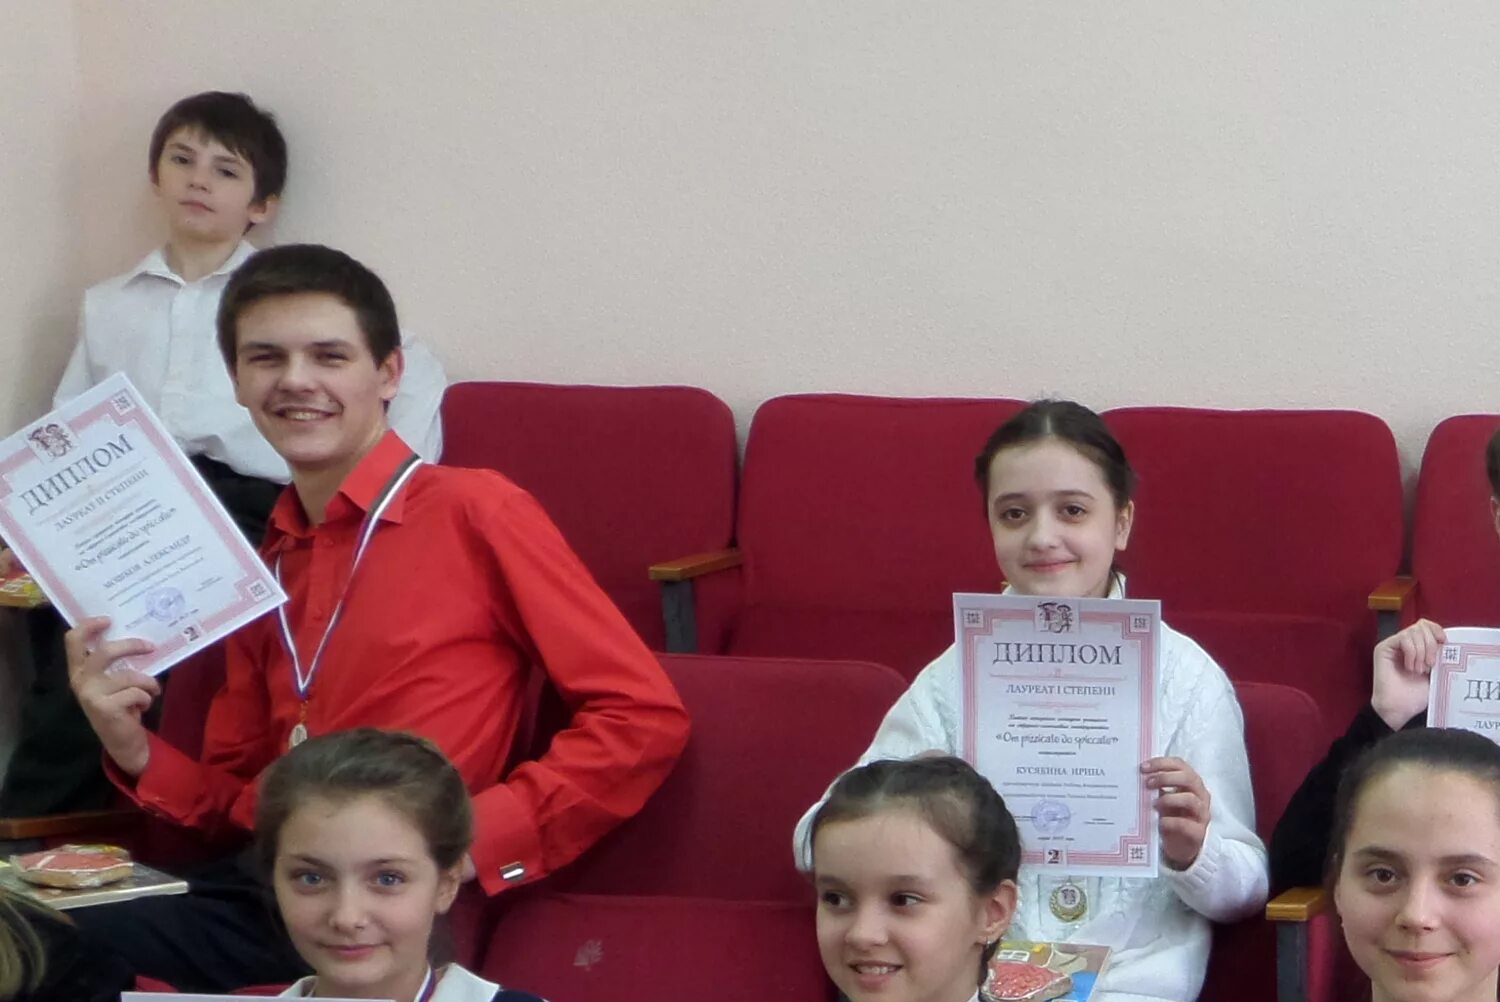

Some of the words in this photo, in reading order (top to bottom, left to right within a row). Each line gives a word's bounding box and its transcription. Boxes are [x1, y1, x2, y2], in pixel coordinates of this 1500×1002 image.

[19, 433, 134, 515] ДИПЛОМ
[184, 626, 199, 640] 2
[992, 642, 1122, 665] ДИПЛОМ
[1006, 685, 1054, 694] ЛАУРЕАТ
[1064, 686, 1116, 696] СТЕПЕНИ
[1048, 850, 1059, 864] 2
